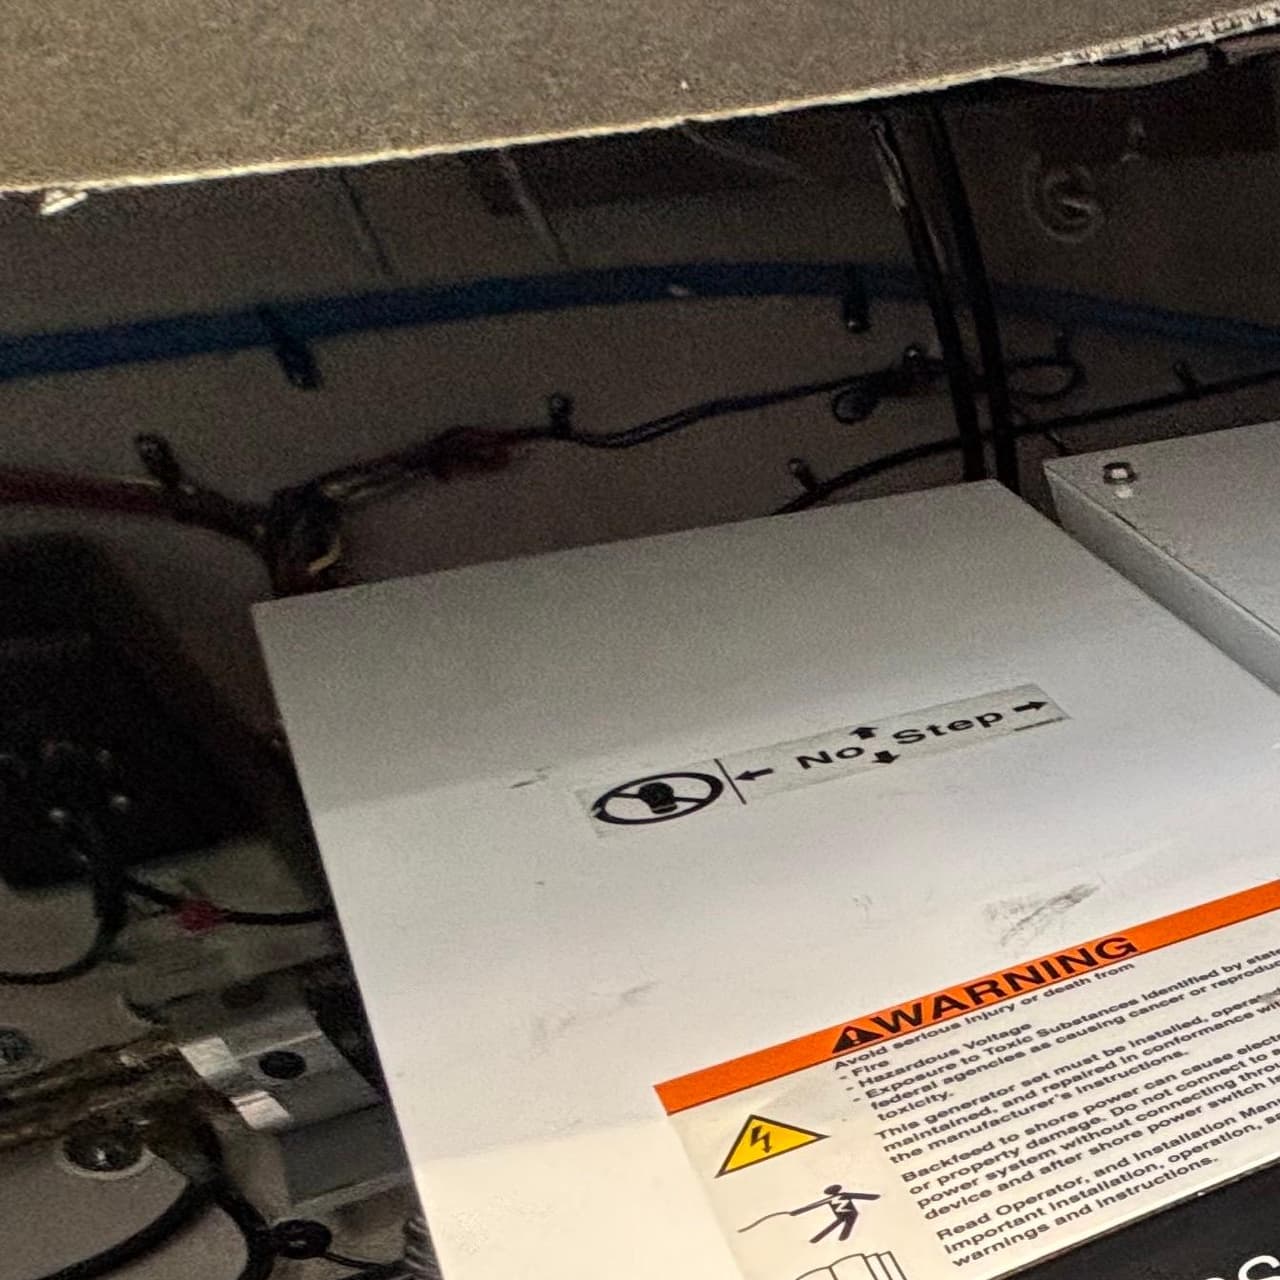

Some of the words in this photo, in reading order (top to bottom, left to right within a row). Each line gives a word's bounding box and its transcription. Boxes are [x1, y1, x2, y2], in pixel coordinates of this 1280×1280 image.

[796, 745, 864, 770] No
[892, 710, 1004, 746] Step
[834, 1046, 888, 1071] Avoid
[892, 1022, 962, 1049] serious
[964, 1003, 1015, 1024] injury
[1019, 994, 1038, 1005] or
[1042, 977, 1092, 997] death
[1093, 963, 1135, 980] from
[864, 1062, 957, 1098] Exposure
[959, 1054, 981, 1064] to
[981, 1035, 1034, 1055] Toxic
[1035, 998, 1139, 1037] Substances
[1140, 968, 1220, 1000] identified
[1220, 961, 1242, 972] by
[869, 936, 1139, 1029] WARNING
[850, 1059, 890, 1077] Fire
[857, 1048, 960, 1088] Hazardous
[961, 1023, 1032, 1049] Voltage
[870, 1080, 938, 1110] federal
[941, 1051, 1026, 1085] agencies
[1029, 1041, 1052, 1053] as
[1055, 1015, 1126, 1044] causing
[1127, 993, 1185, 1018] cancer
[1188, 985, 1207, 996] or
[873, 1120, 920, 1139] This
[923, 1084, 1015, 1124] generator
[1019, 1071, 1051, 1087] set
[1052, 1053, 1101, 1075] must
[1101, 1045, 1126, 1057] be
[1127, 1015, 1209, 1048] installed,
[876, 1090, 954, 1121] toxicity.
[882, 1105, 998, 1152] maintained,
[1001, 1089, 1038, 1108] and
[1041, 1059, 1117, 1093] repaired
[1119, 1053, 1139, 1064] in
[1141, 1011, 1254, 1056] conformance
[888, 1147, 923, 1164] the
[927, 1091, 1073, 1150] manufacturer's
[1074, 1050, 1189, 1094] instructions.
[900, 1140, 996, 1182] Backfeed
[997, 1133, 1020, 1145] to
[1023, 1110, 1079, 1135] shore
[1081, 1086, 1139, 1115] power
[1143, 1073, 1178, 1090] can
[1179, 1052, 1233, 1076] cause
[908, 1180, 930, 1194] or
[935, 1146, 1020, 1186] property
[1025, 1116, 1107, 1149] damage.
[1108, 1103, 1138, 1117] Do
[1140, 1088, 1173, 1105] not
[1174, 1060, 1247, 1092] connect
[1248, 1053, 1268, 1064] to
[916, 1177, 979, 1210] power
[984, 1148, 1057, 1180] system
[1058, 1118, 1133, 1150] without
[1134, 1079, 1237, 1121] connecting
[923, 1188, 992, 1220] device
[996, 1170, 1035, 1191] and
[1038, 1151, 1082, 1175] after
[1087, 1129, 1144, 1155] shore
[1146, 1105, 1202, 1134] power
[1206, 1082, 1267, 1109] switch
[935, 1212, 992, 1240] Read
[994, 1175, 1090, 1215] Operator,
[1092, 1156, 1131, 1177] and
[1131, 1116, 1237, 1161] Installation
[943, 1207, 1047, 1254] important
[1047, 1163, 1165, 1211] installation,
[1167, 1124, 1263, 1163] operation,
[951, 1223, 1050, 1267] warnings
[1053, 1203, 1093, 1226] and
[1095, 1157, 1219, 1208] instructions.
